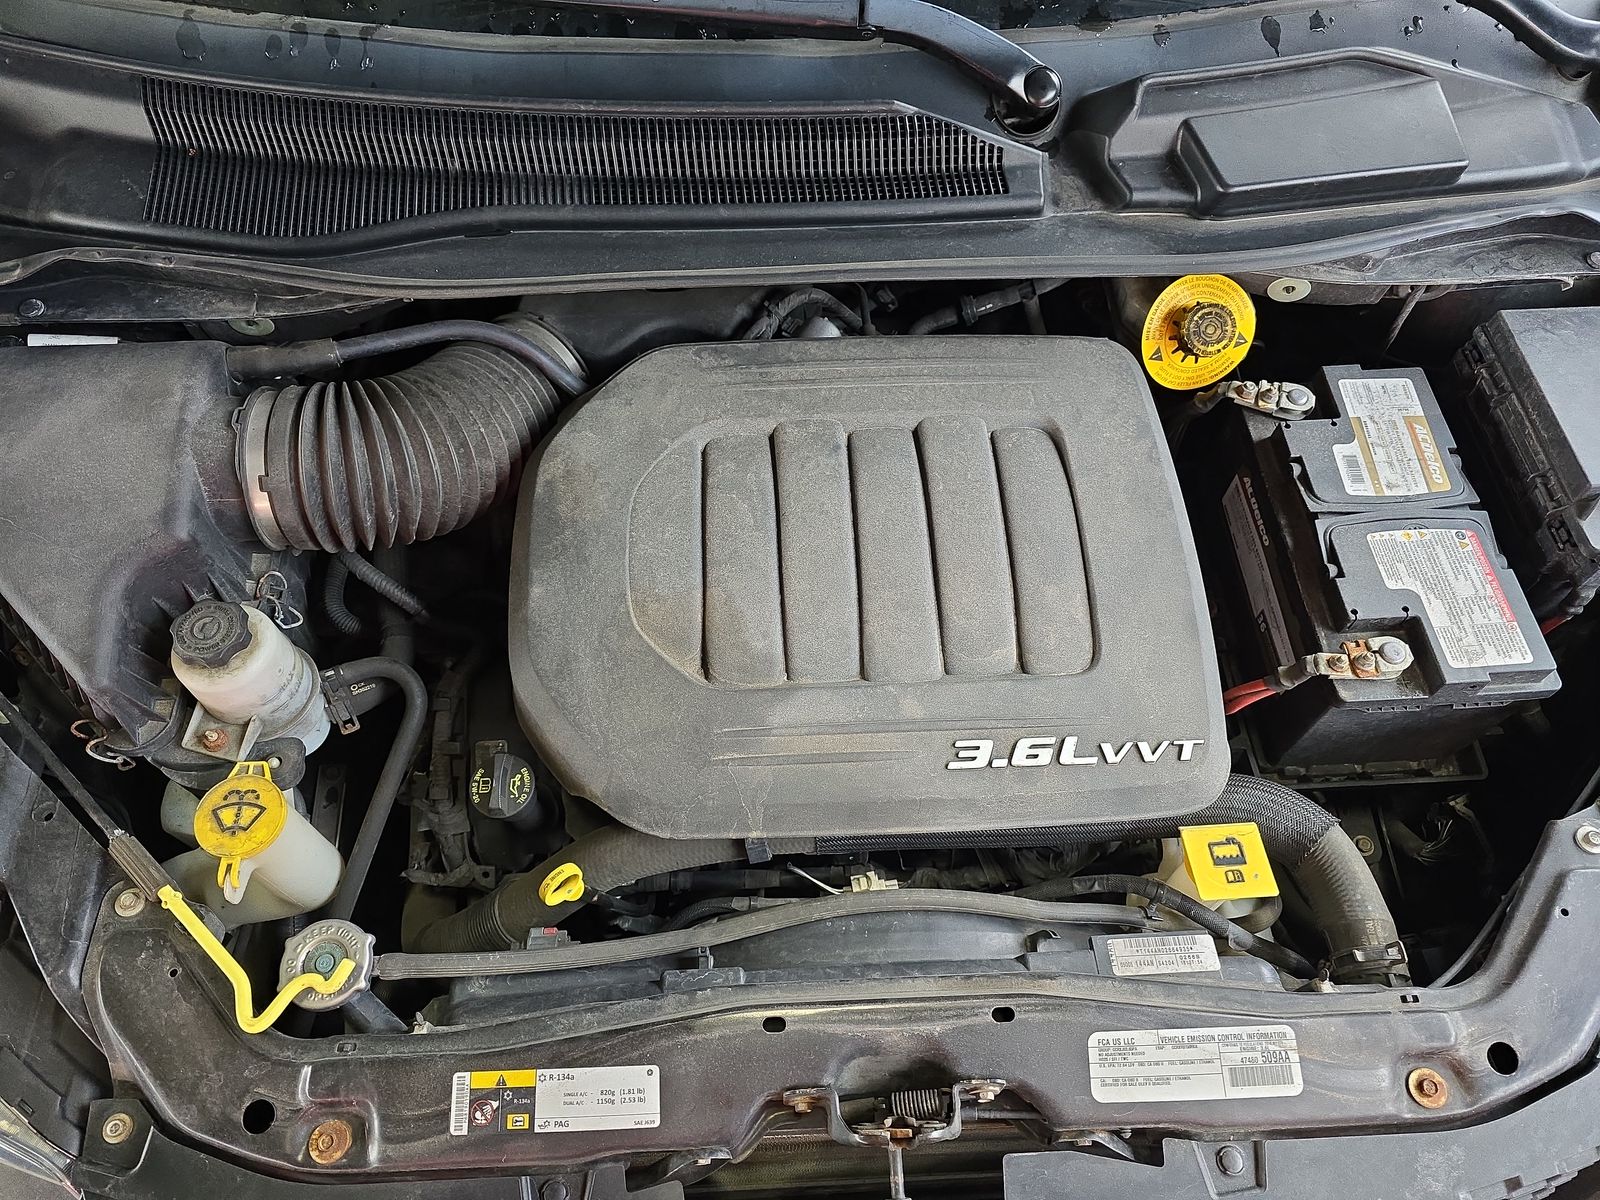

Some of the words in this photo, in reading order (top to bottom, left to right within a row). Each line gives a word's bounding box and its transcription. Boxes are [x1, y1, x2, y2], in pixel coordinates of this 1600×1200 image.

[946, 736, 1099, 770] 3.6L
[1099, 738, 1205, 765] VVT
[474, 768, 484, 782] SAE
[520, 767, 531, 792] ENGINE
[472, 782, 480, 804] 5W-20
[516, 793, 528, 804] OIL
[304, 925, 334, 943] KEEP
[1098, 1038, 1110, 1046] FCA
[1112, 1038, 1122, 1046] US
[1124, 1037, 1135, 1045] LLC
[1160, 1035, 1186, 1044] VEHICLE
[1186, 1034, 1216, 1043] EMISSION
[1218, 1033, 1245, 1042] CONTROL
[1246, 1032, 1288, 1040] INFORMATION
[1260, 1051, 1291, 1064] 509AA
[548, 1073, 575, 1082] R-134a
[600, 1089, 616, 1098] 820g
[619, 1088, 634, 1096] (1.81
[635, 1087, 646, 1095] lb)
[596, 1098, 616, 1106] 1150g
[620, 1096, 636, 1105] (2.53
[636, 1096, 646, 1104] lb)
[554, 1120, 570, 1128] PAG
